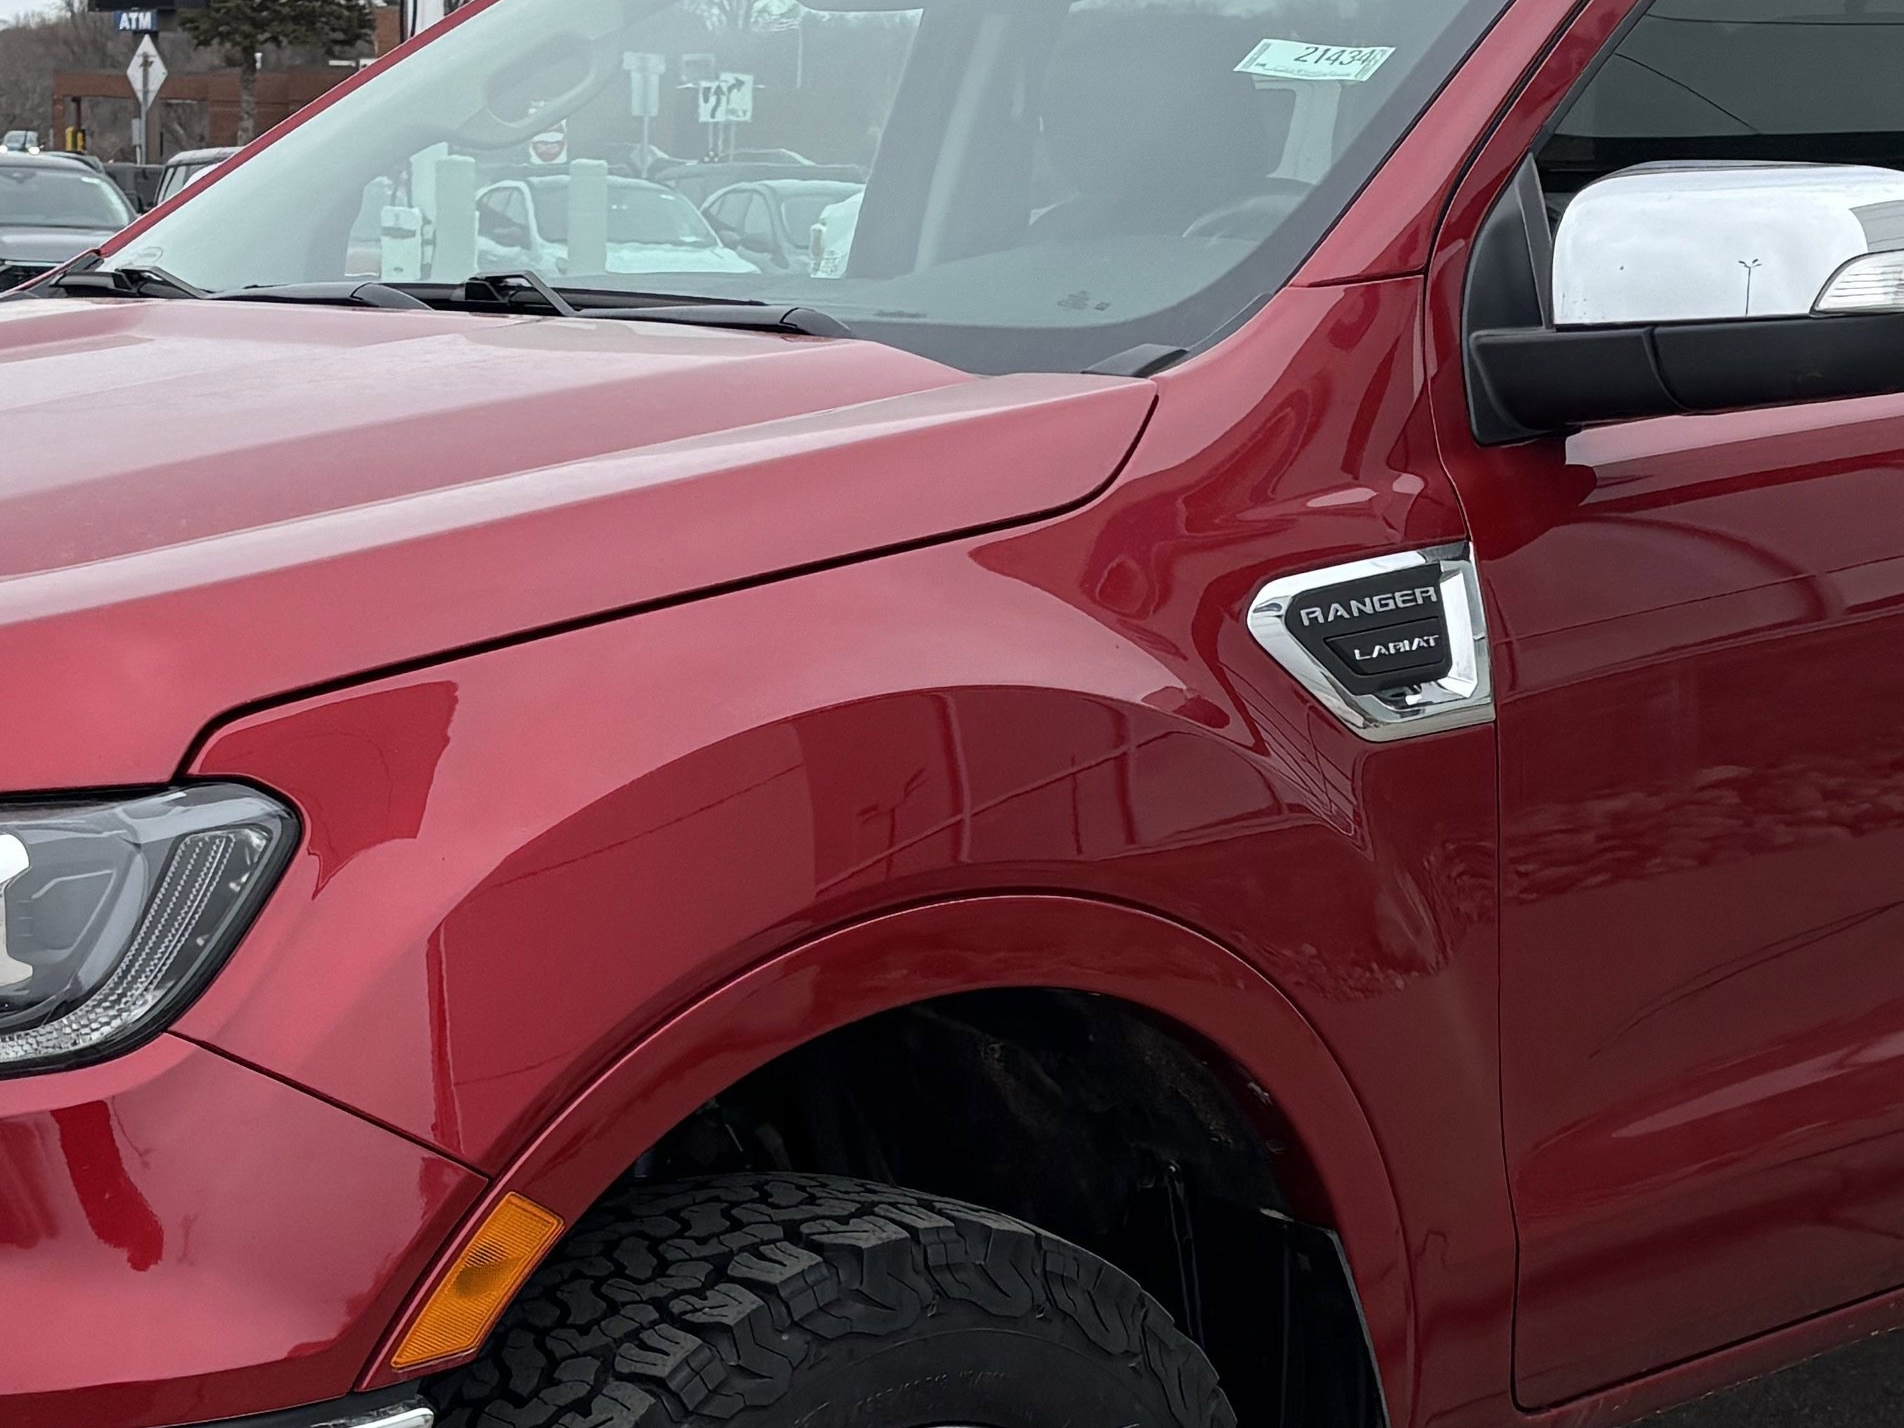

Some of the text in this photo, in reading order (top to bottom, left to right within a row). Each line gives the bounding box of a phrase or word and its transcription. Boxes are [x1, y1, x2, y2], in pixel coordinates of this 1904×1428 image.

[119, 11, 152, 30] ATM
[1300, 585, 1438, 627] RANGER
[1353, 634, 1439, 661] LARIAT
